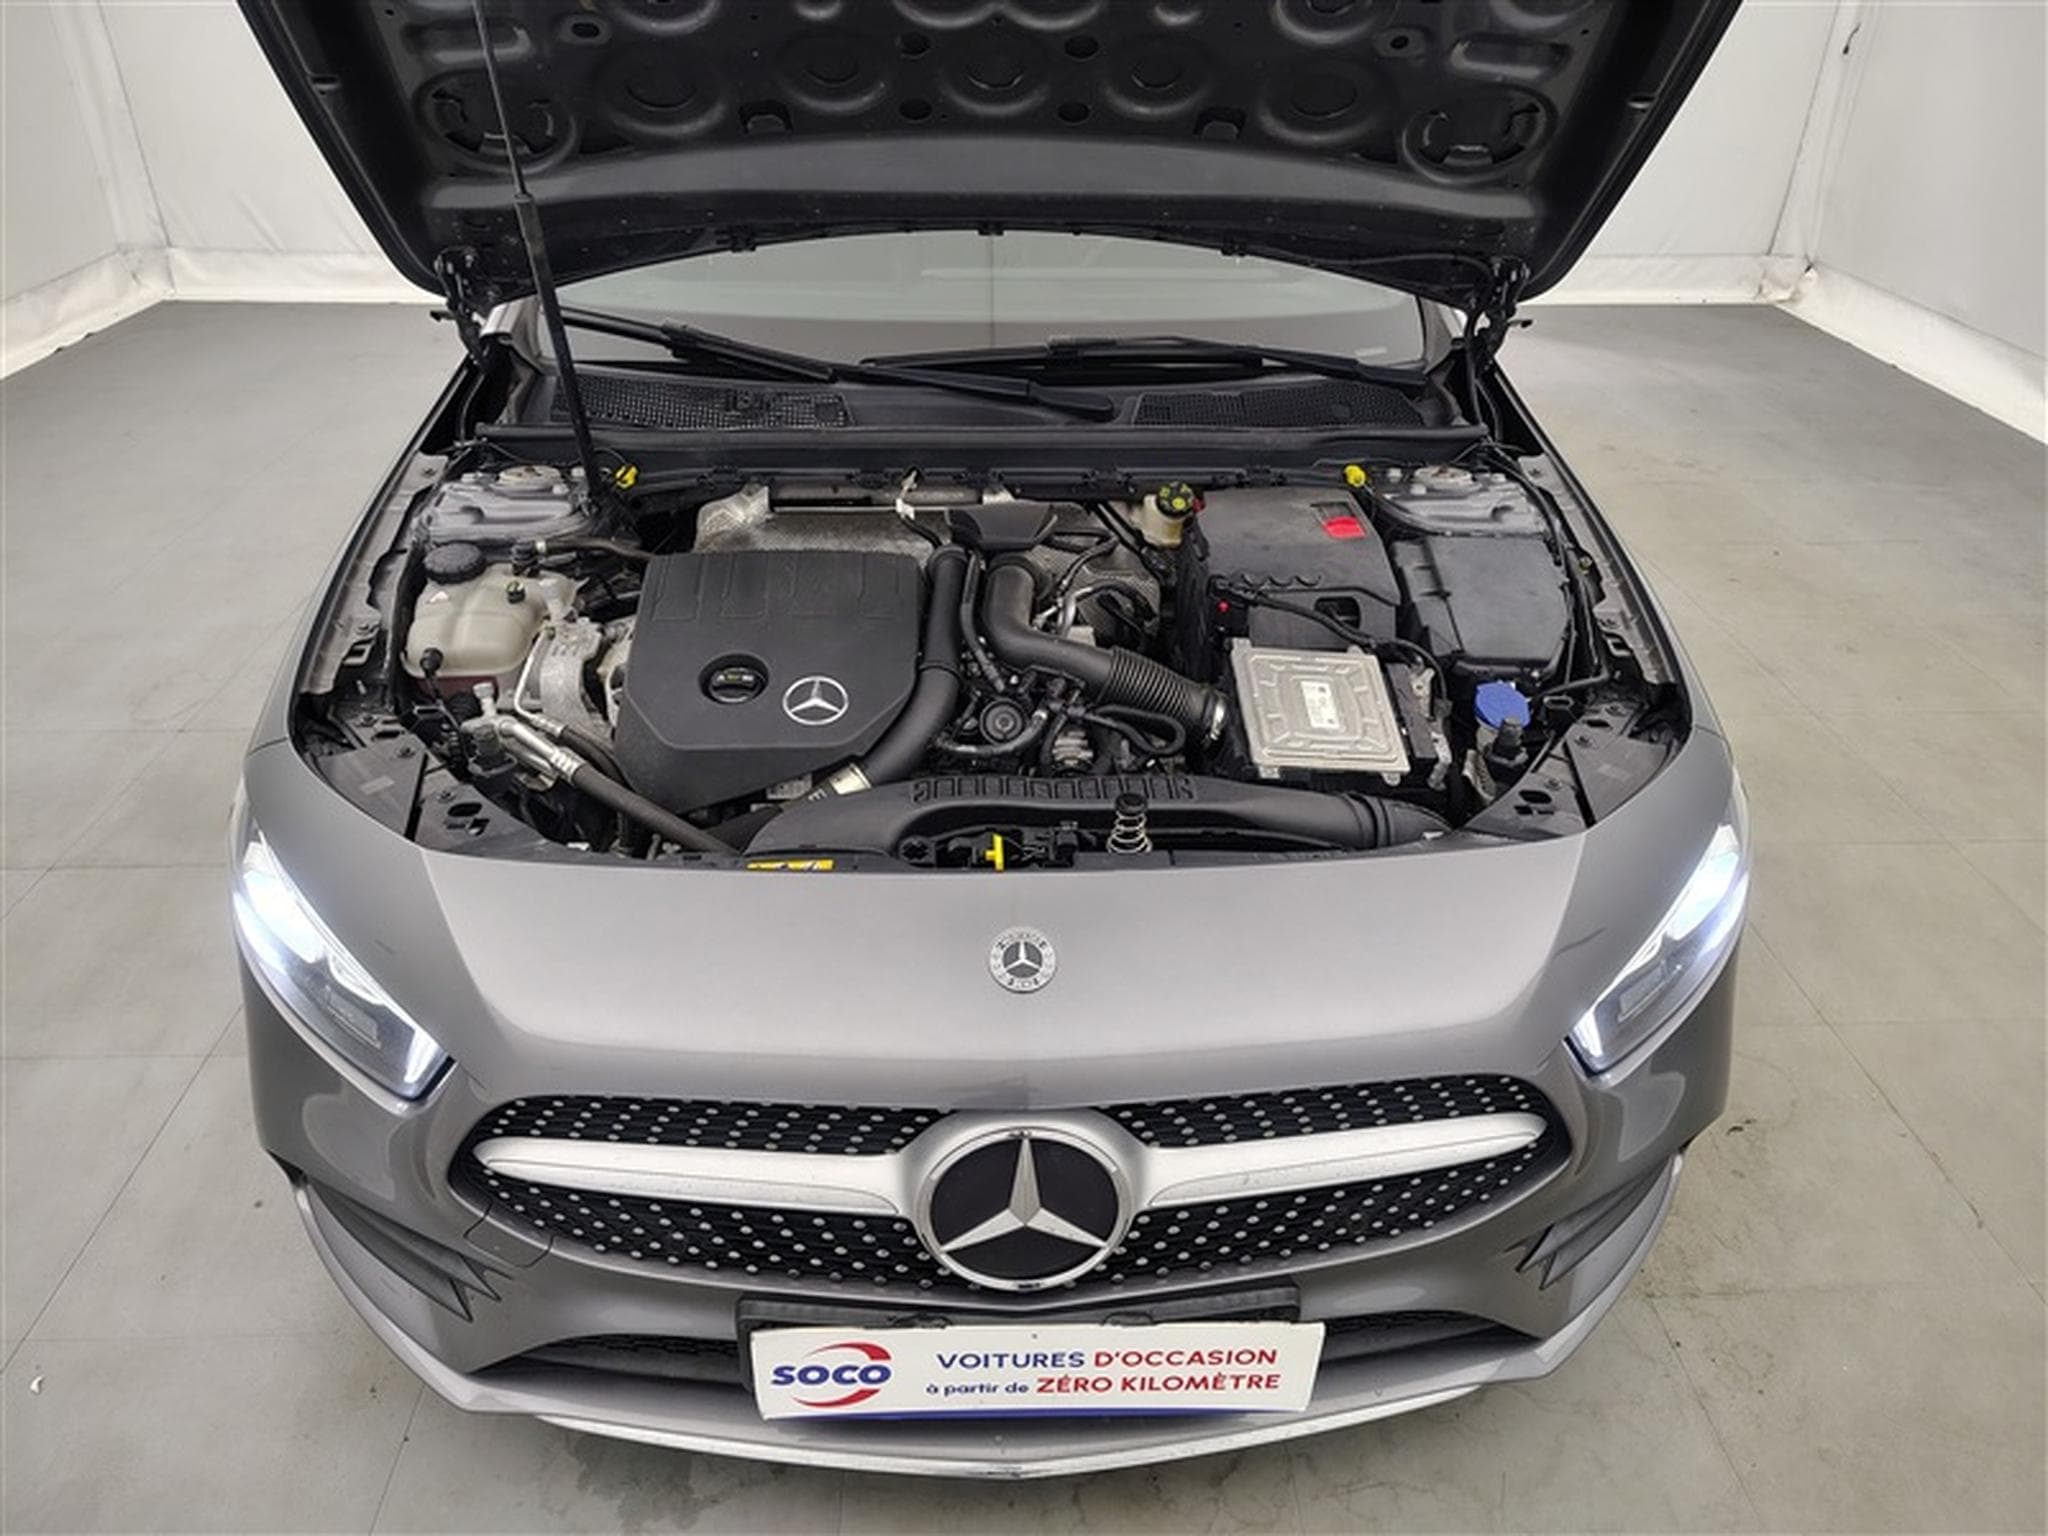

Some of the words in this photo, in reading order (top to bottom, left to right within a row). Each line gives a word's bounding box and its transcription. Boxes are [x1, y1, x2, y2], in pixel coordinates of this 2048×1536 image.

[936, 1352, 1085, 1369] VOITURES
[1093, 1349, 1277, 1368] D'OCCASION
[771, 1364, 892, 1386] SOCO
[926, 1383, 939, 1394] à
[943, 1383, 999, 1398] partir
[1004, 1382, 1030, 1393] de
[1036, 1374, 1113, 1394] ZÉRO
[1120, 1371, 1281, 1392] KILOMÈTRE
